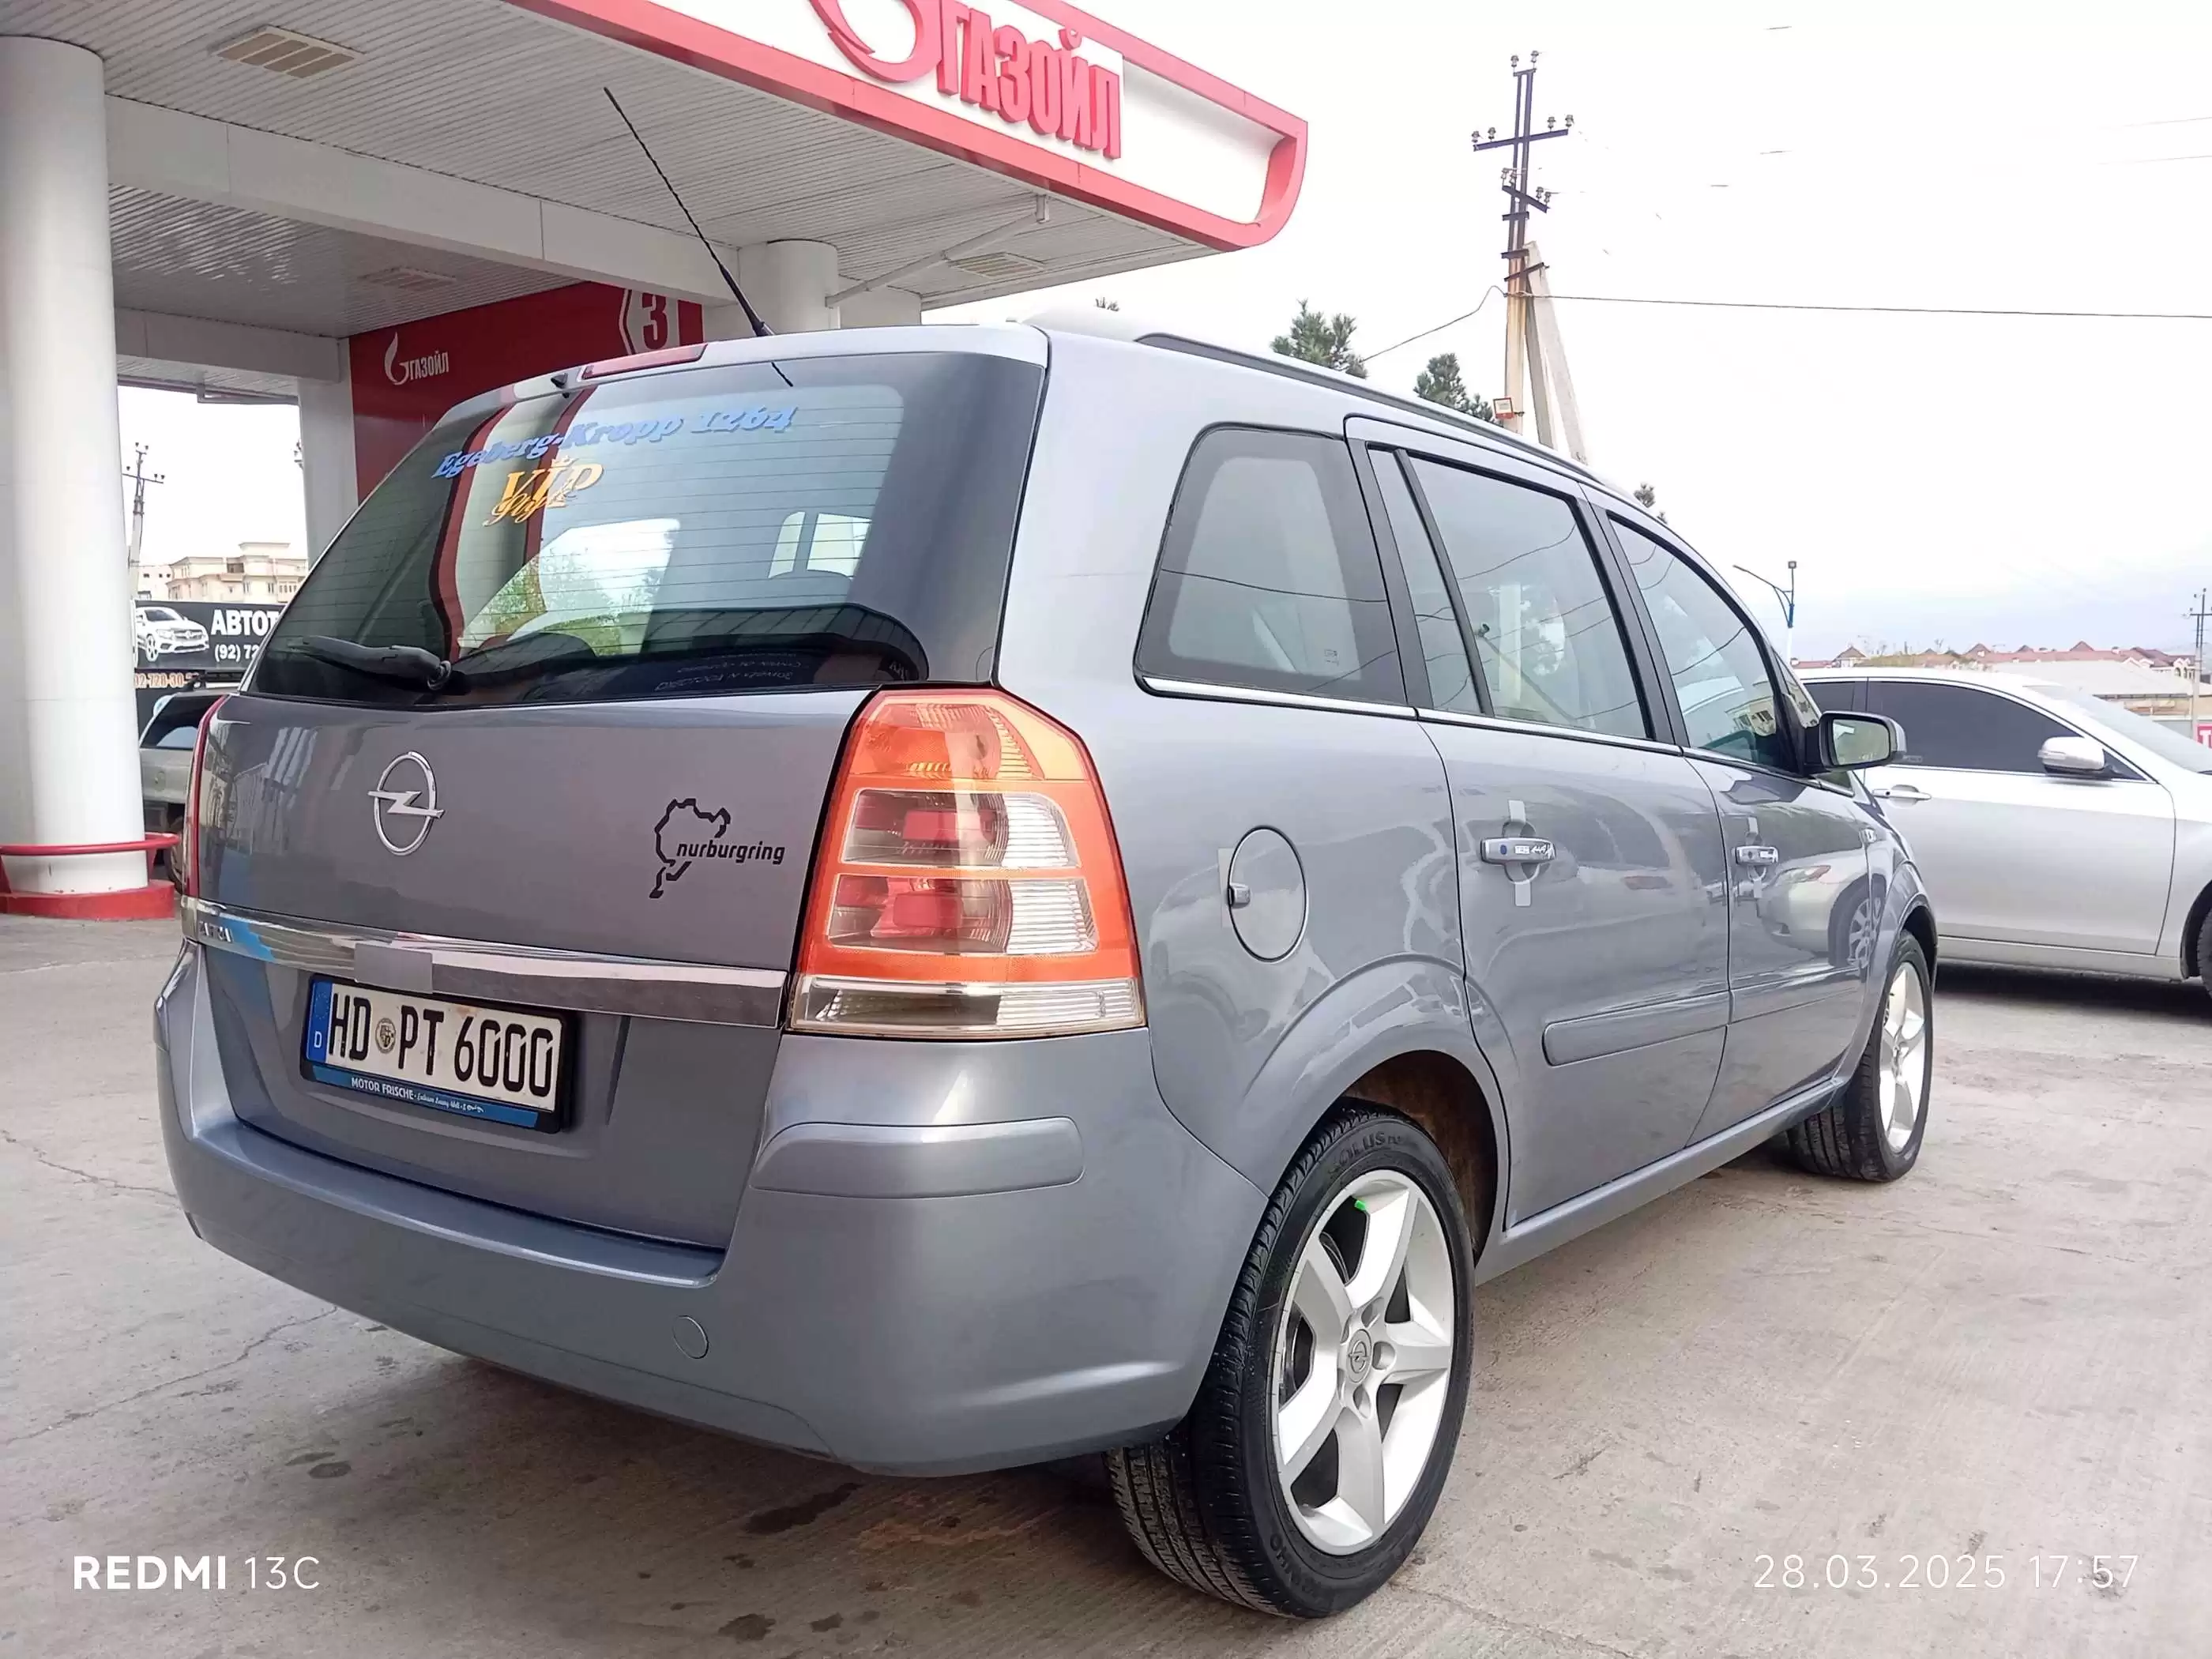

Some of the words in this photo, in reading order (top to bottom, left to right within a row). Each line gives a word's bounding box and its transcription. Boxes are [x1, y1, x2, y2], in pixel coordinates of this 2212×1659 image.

[936, 0, 1122, 160] ГАЗОЙЛ
[641, 292, 670, 351] 3
[409, 349, 450, 381] ГАЗОЙЛ
[690, 405, 798, 435] 1264
[498, 464, 604, 511] VIP
[215, 644, 241, 662] (92)
[676, 840, 785, 865] nurburgring
[314, 1030, 322, 1049] D
[329, 993, 372, 1061] HD
[398, 1004, 445, 1076] PT
[453, 1015, 554, 1097] 6000
[351, 1077, 380, 1092] MOTOR
[382, 1083, 414, 1100] FRISCHE
